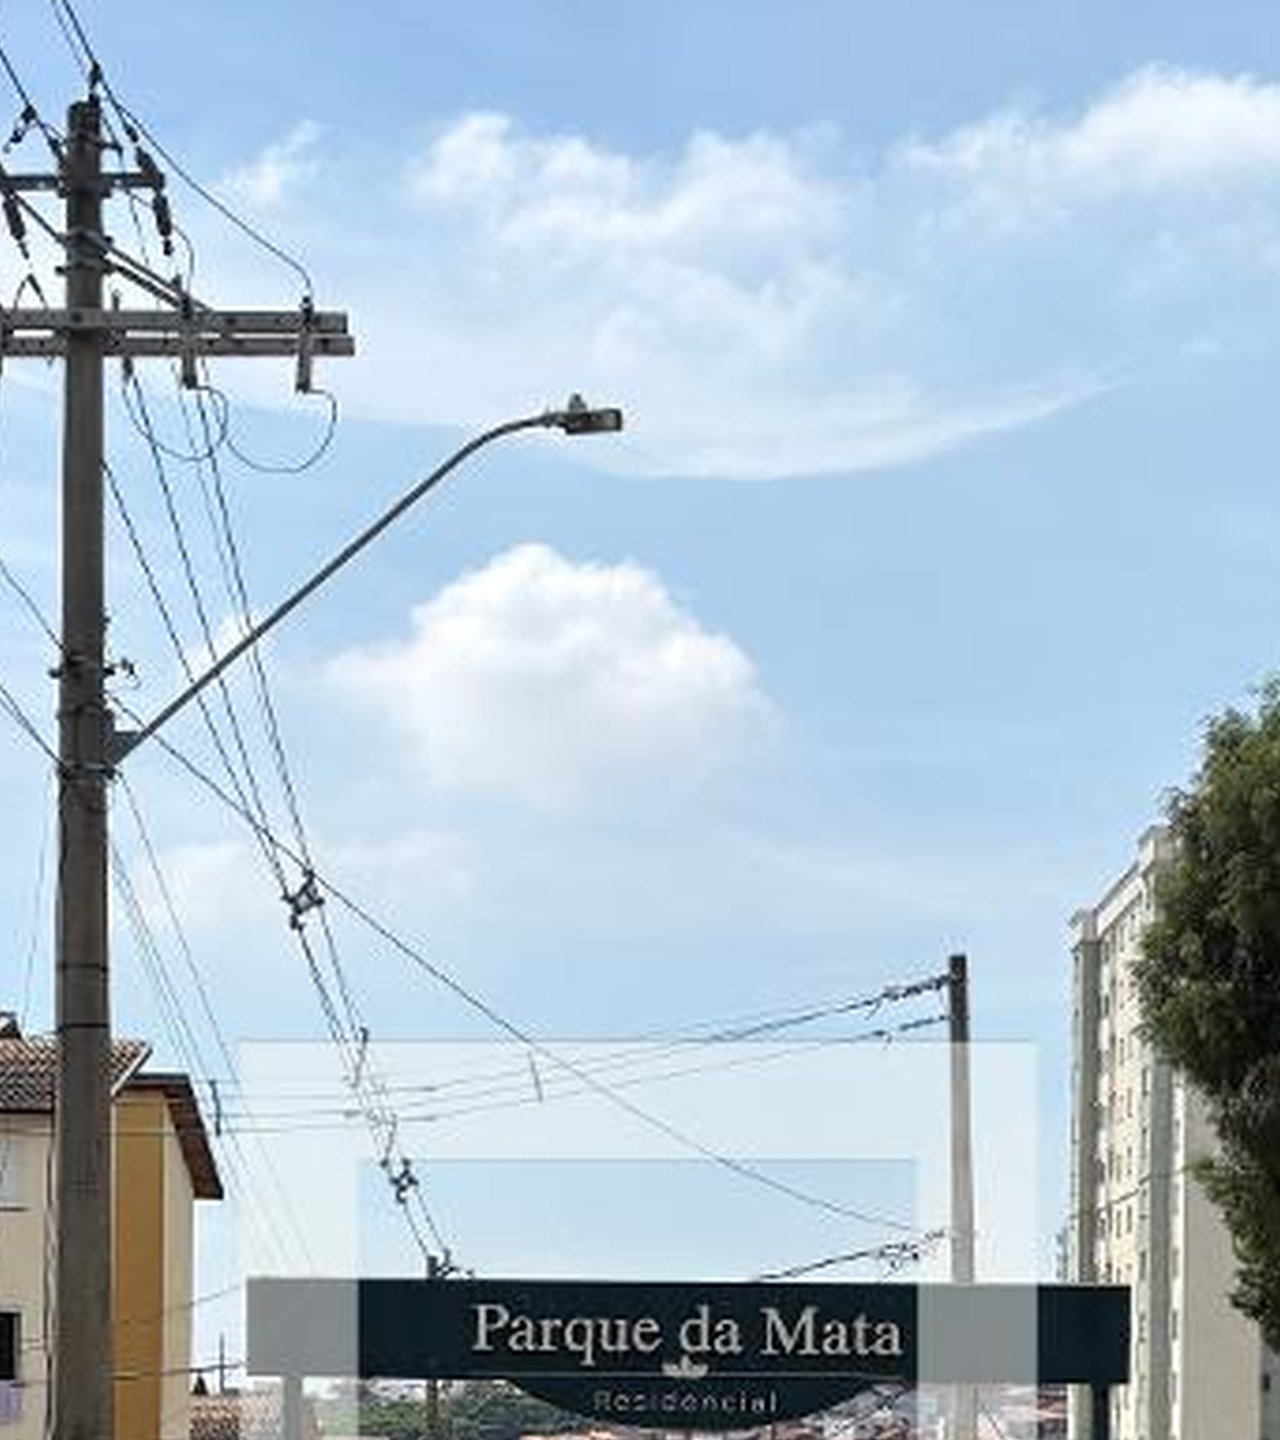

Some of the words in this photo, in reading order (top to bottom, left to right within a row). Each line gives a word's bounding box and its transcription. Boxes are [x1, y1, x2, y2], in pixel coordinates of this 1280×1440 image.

[471, 1304, 662, 1367] Parque
[678, 1304, 744, 1354] da
[760, 1307, 904, 1356] Mata
[592, 1390, 778, 1412] Residencial
